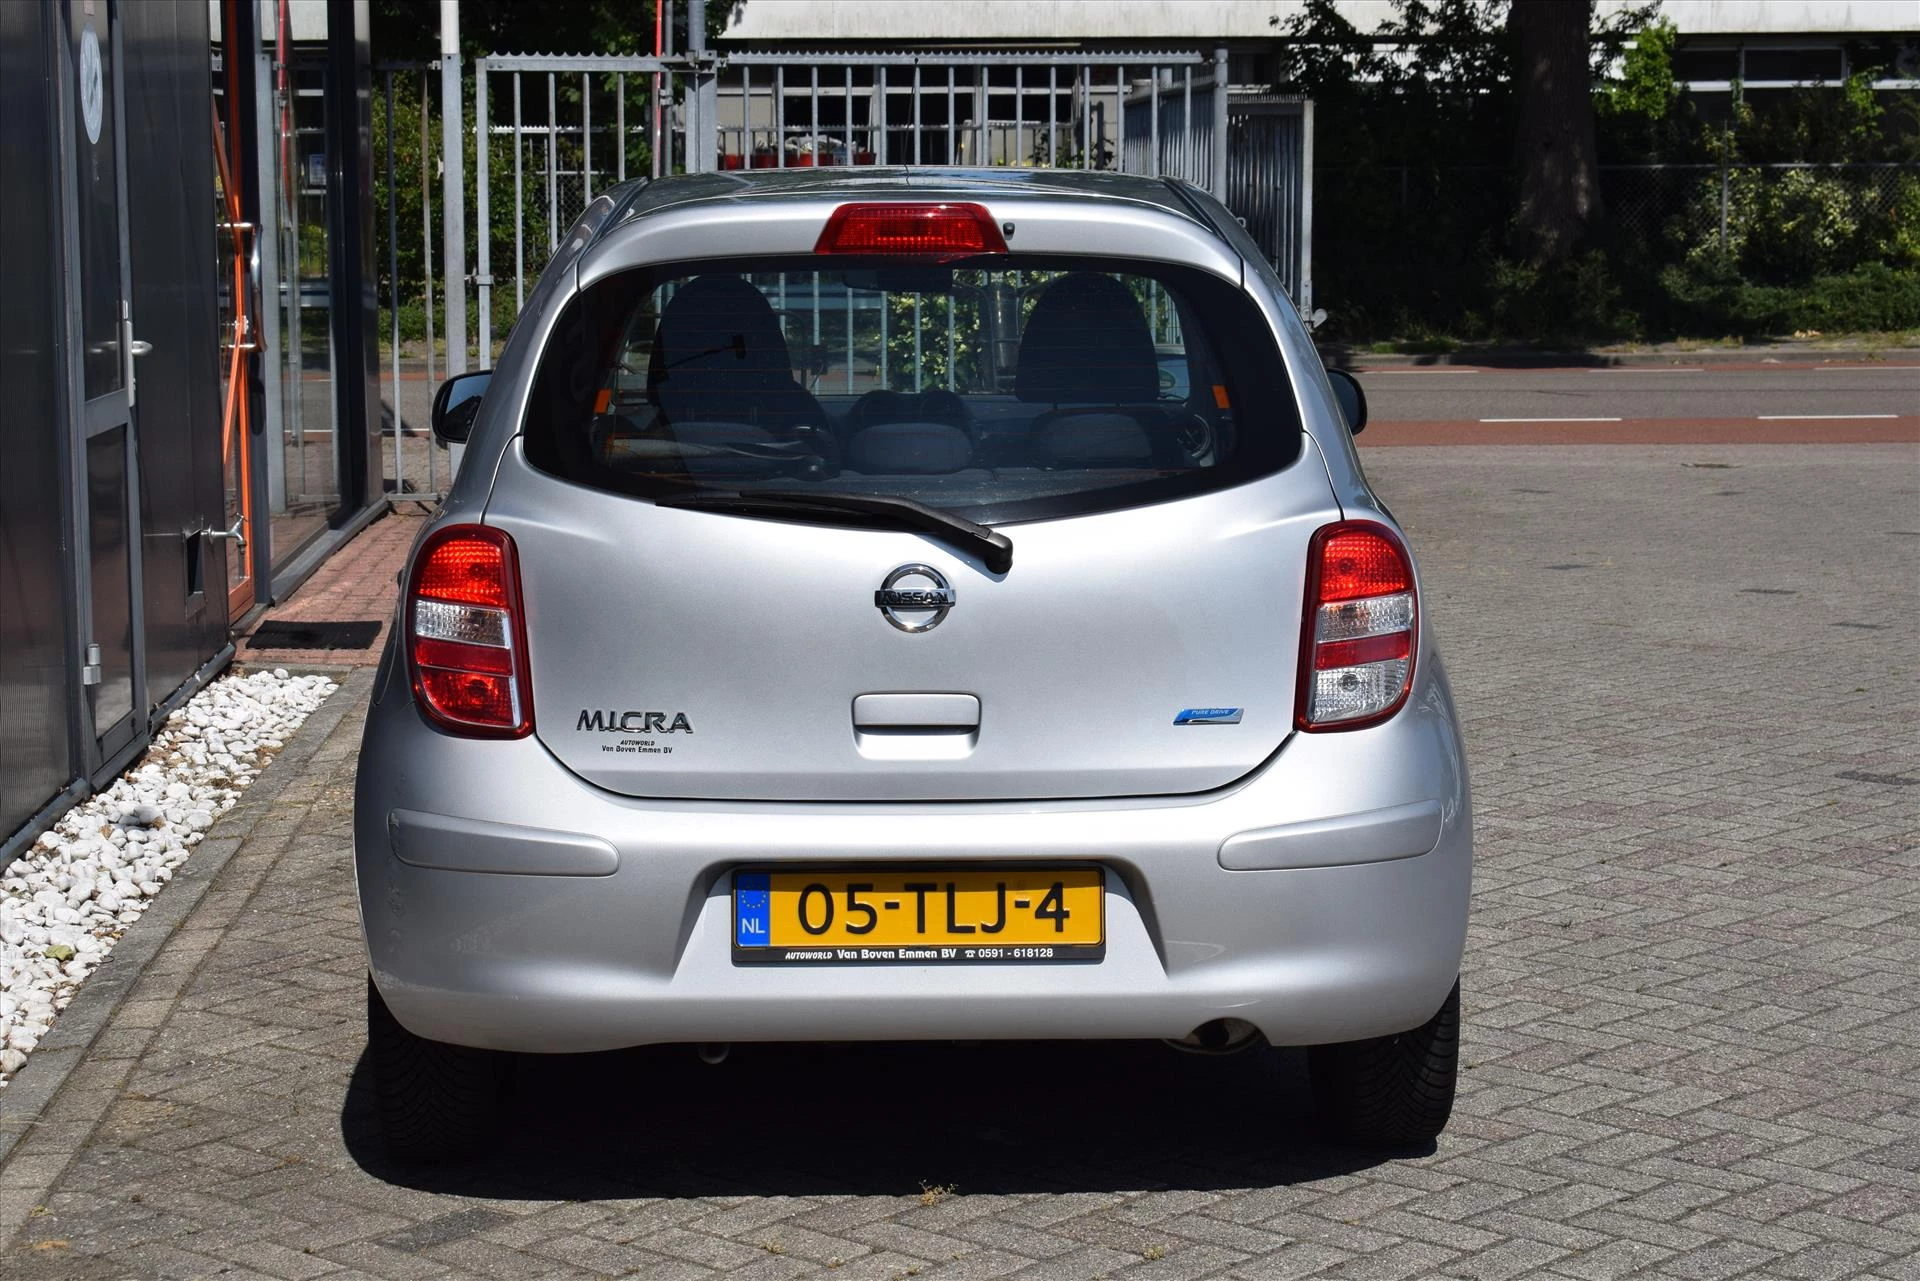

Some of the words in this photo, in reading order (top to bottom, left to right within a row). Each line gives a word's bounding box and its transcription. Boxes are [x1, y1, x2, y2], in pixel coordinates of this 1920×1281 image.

[882, 590, 948, 604] NISSAN
[576, 709, 694, 734] MICRA
[616, 745, 636, 753] Boven
[797, 882, 1070, 936] 05-TLJ-4
[741, 918, 765, 934] NL
[785, 951, 833, 960] AUTOWORLD
[837, 949, 858, 960] Van
[861, 949, 895, 959] Boven
[898, 949, 937, 959] Emmen
[941, 948, 957, 959] BV
[978, 948, 1004, 958] 0591
[1014, 948, 1053, 958] 618128
